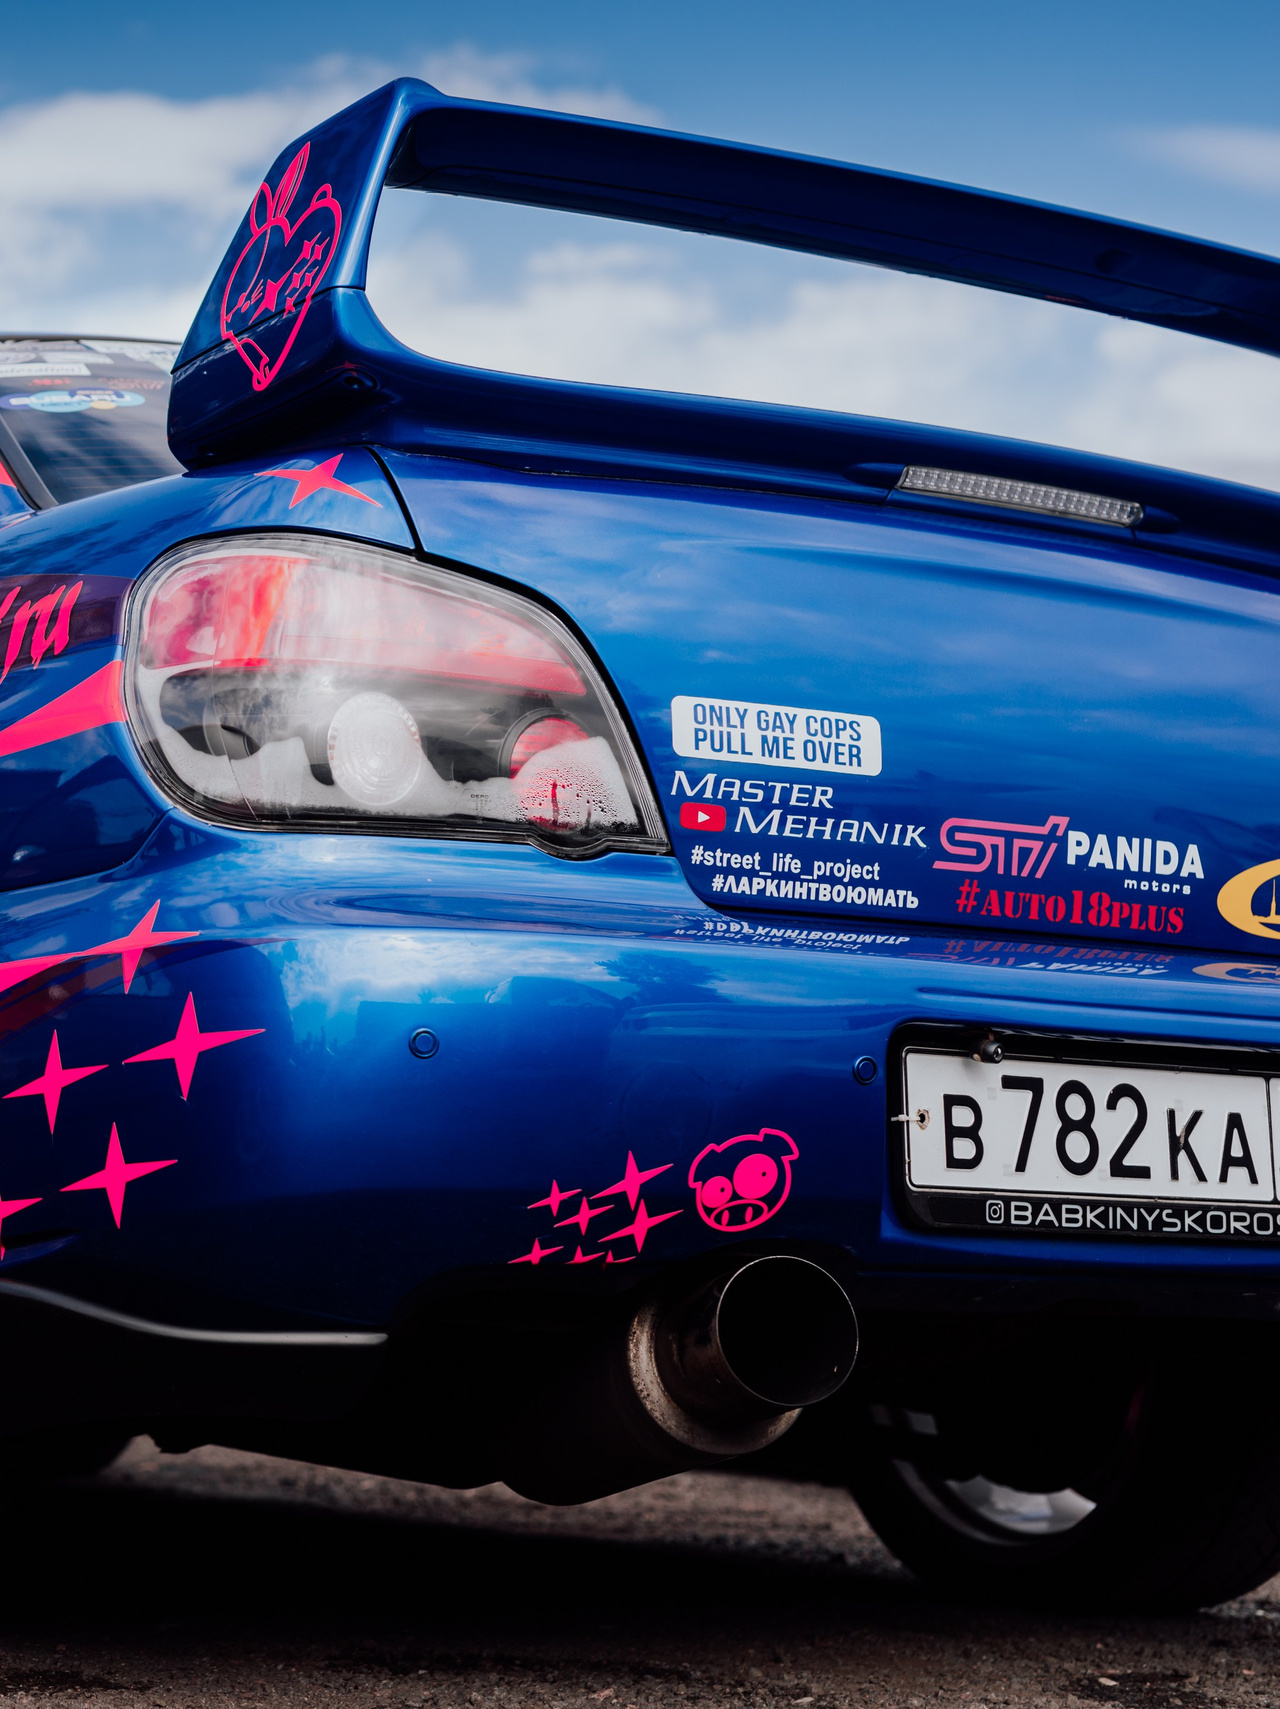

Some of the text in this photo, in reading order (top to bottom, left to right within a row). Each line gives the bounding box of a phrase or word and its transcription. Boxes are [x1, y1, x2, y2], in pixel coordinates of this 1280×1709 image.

[693, 703, 862, 741] ONLY GAY COPS
[694, 728, 862, 767] PULL ME OVER
[670, 770, 834, 809] MASTER
[734, 806, 928, 848] MEHANIK
[691, 845, 880, 883] #street_life_project
[1067, 830, 1205, 879] PANIDA
[956, 878, 1185, 934] #AUTO18PLUS
[1124, 879, 1191, 895] motors
[1010, 1201, 1280, 1236] BABKINYSKORO
